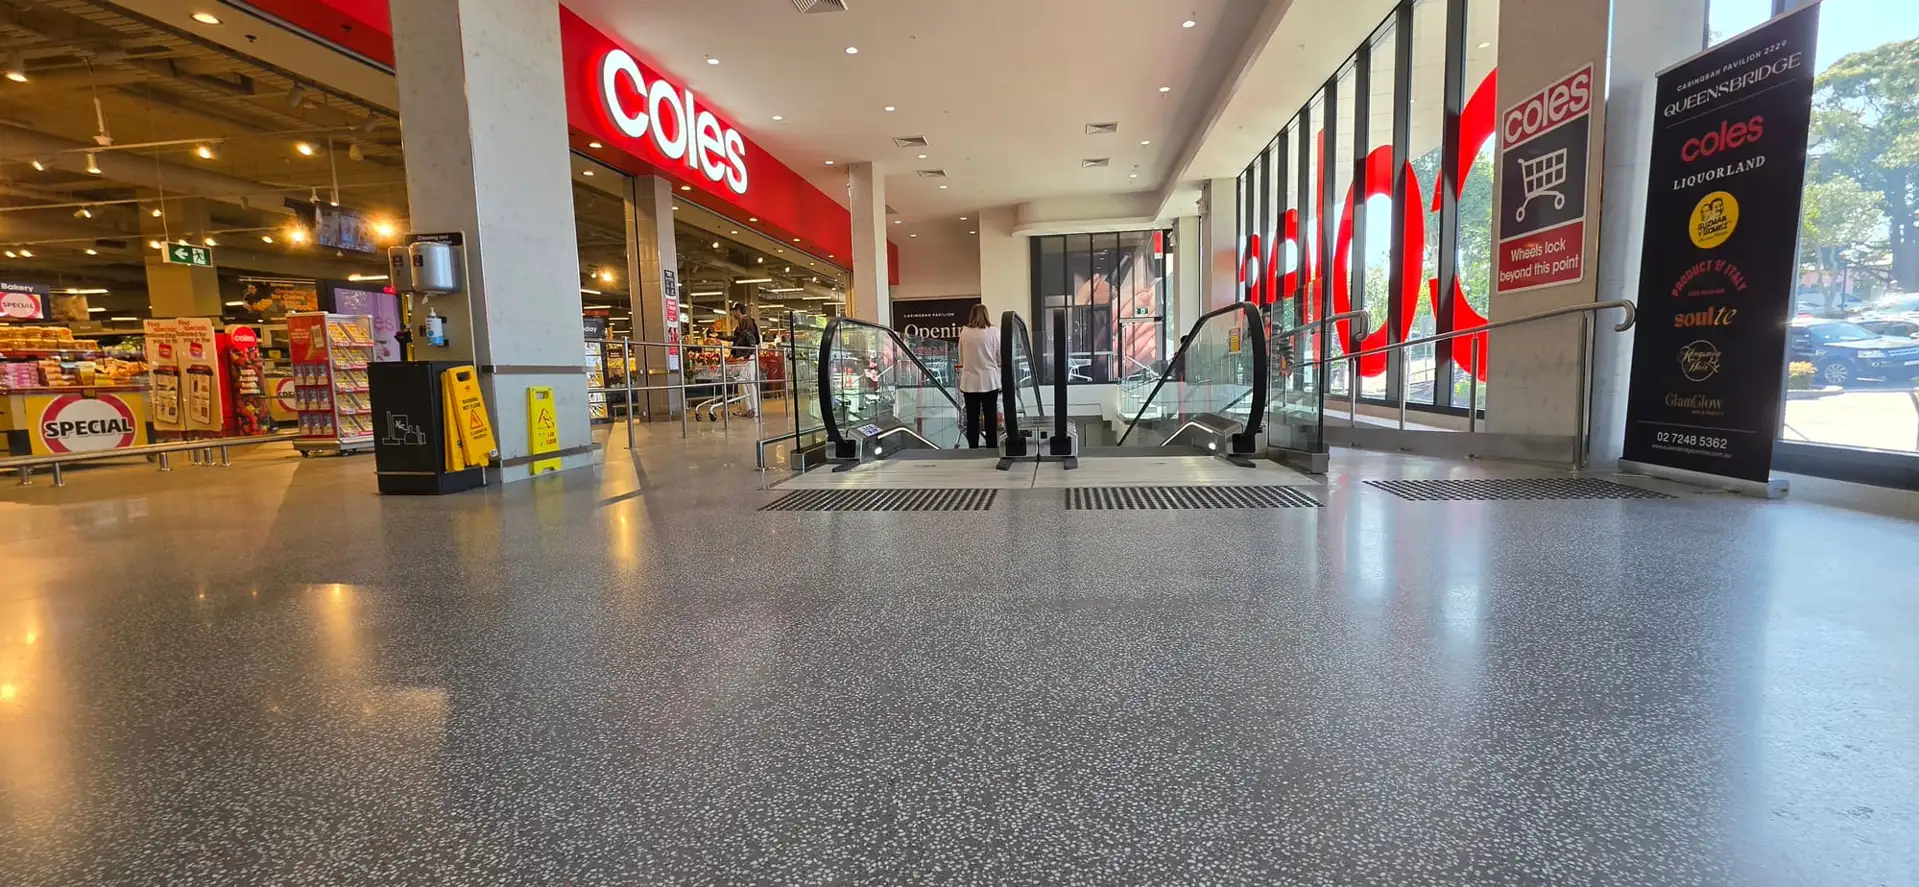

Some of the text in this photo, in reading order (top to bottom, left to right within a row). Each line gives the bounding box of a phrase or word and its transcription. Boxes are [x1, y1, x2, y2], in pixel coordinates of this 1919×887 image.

[1676, 40, 1787, 92] CARINGBAH PAVILION 2229
[1664, 52, 1802, 117] QUEENSBRIDGE
[603, 49, 748, 194] coles
[1505, 74, 1589, 143] coles
[1681, 115, 1764, 162] coles
[1673, 155, 1766, 190] LIQUORLAND
[1511, 238, 1566, 262] Wheels lock
[1500, 254, 1580, 282] beyond this point
[1671, 260, 1712, 297] PRODUCT
[1724, 263, 1748, 291] ITALY
[1, 282, 34, 292] Bakery
[1664, 392, 1722, 409] GlamGlow
[44, 418, 133, 438] SPECIAL
[1657, 431, 1728, 449] 02 7248 5362
